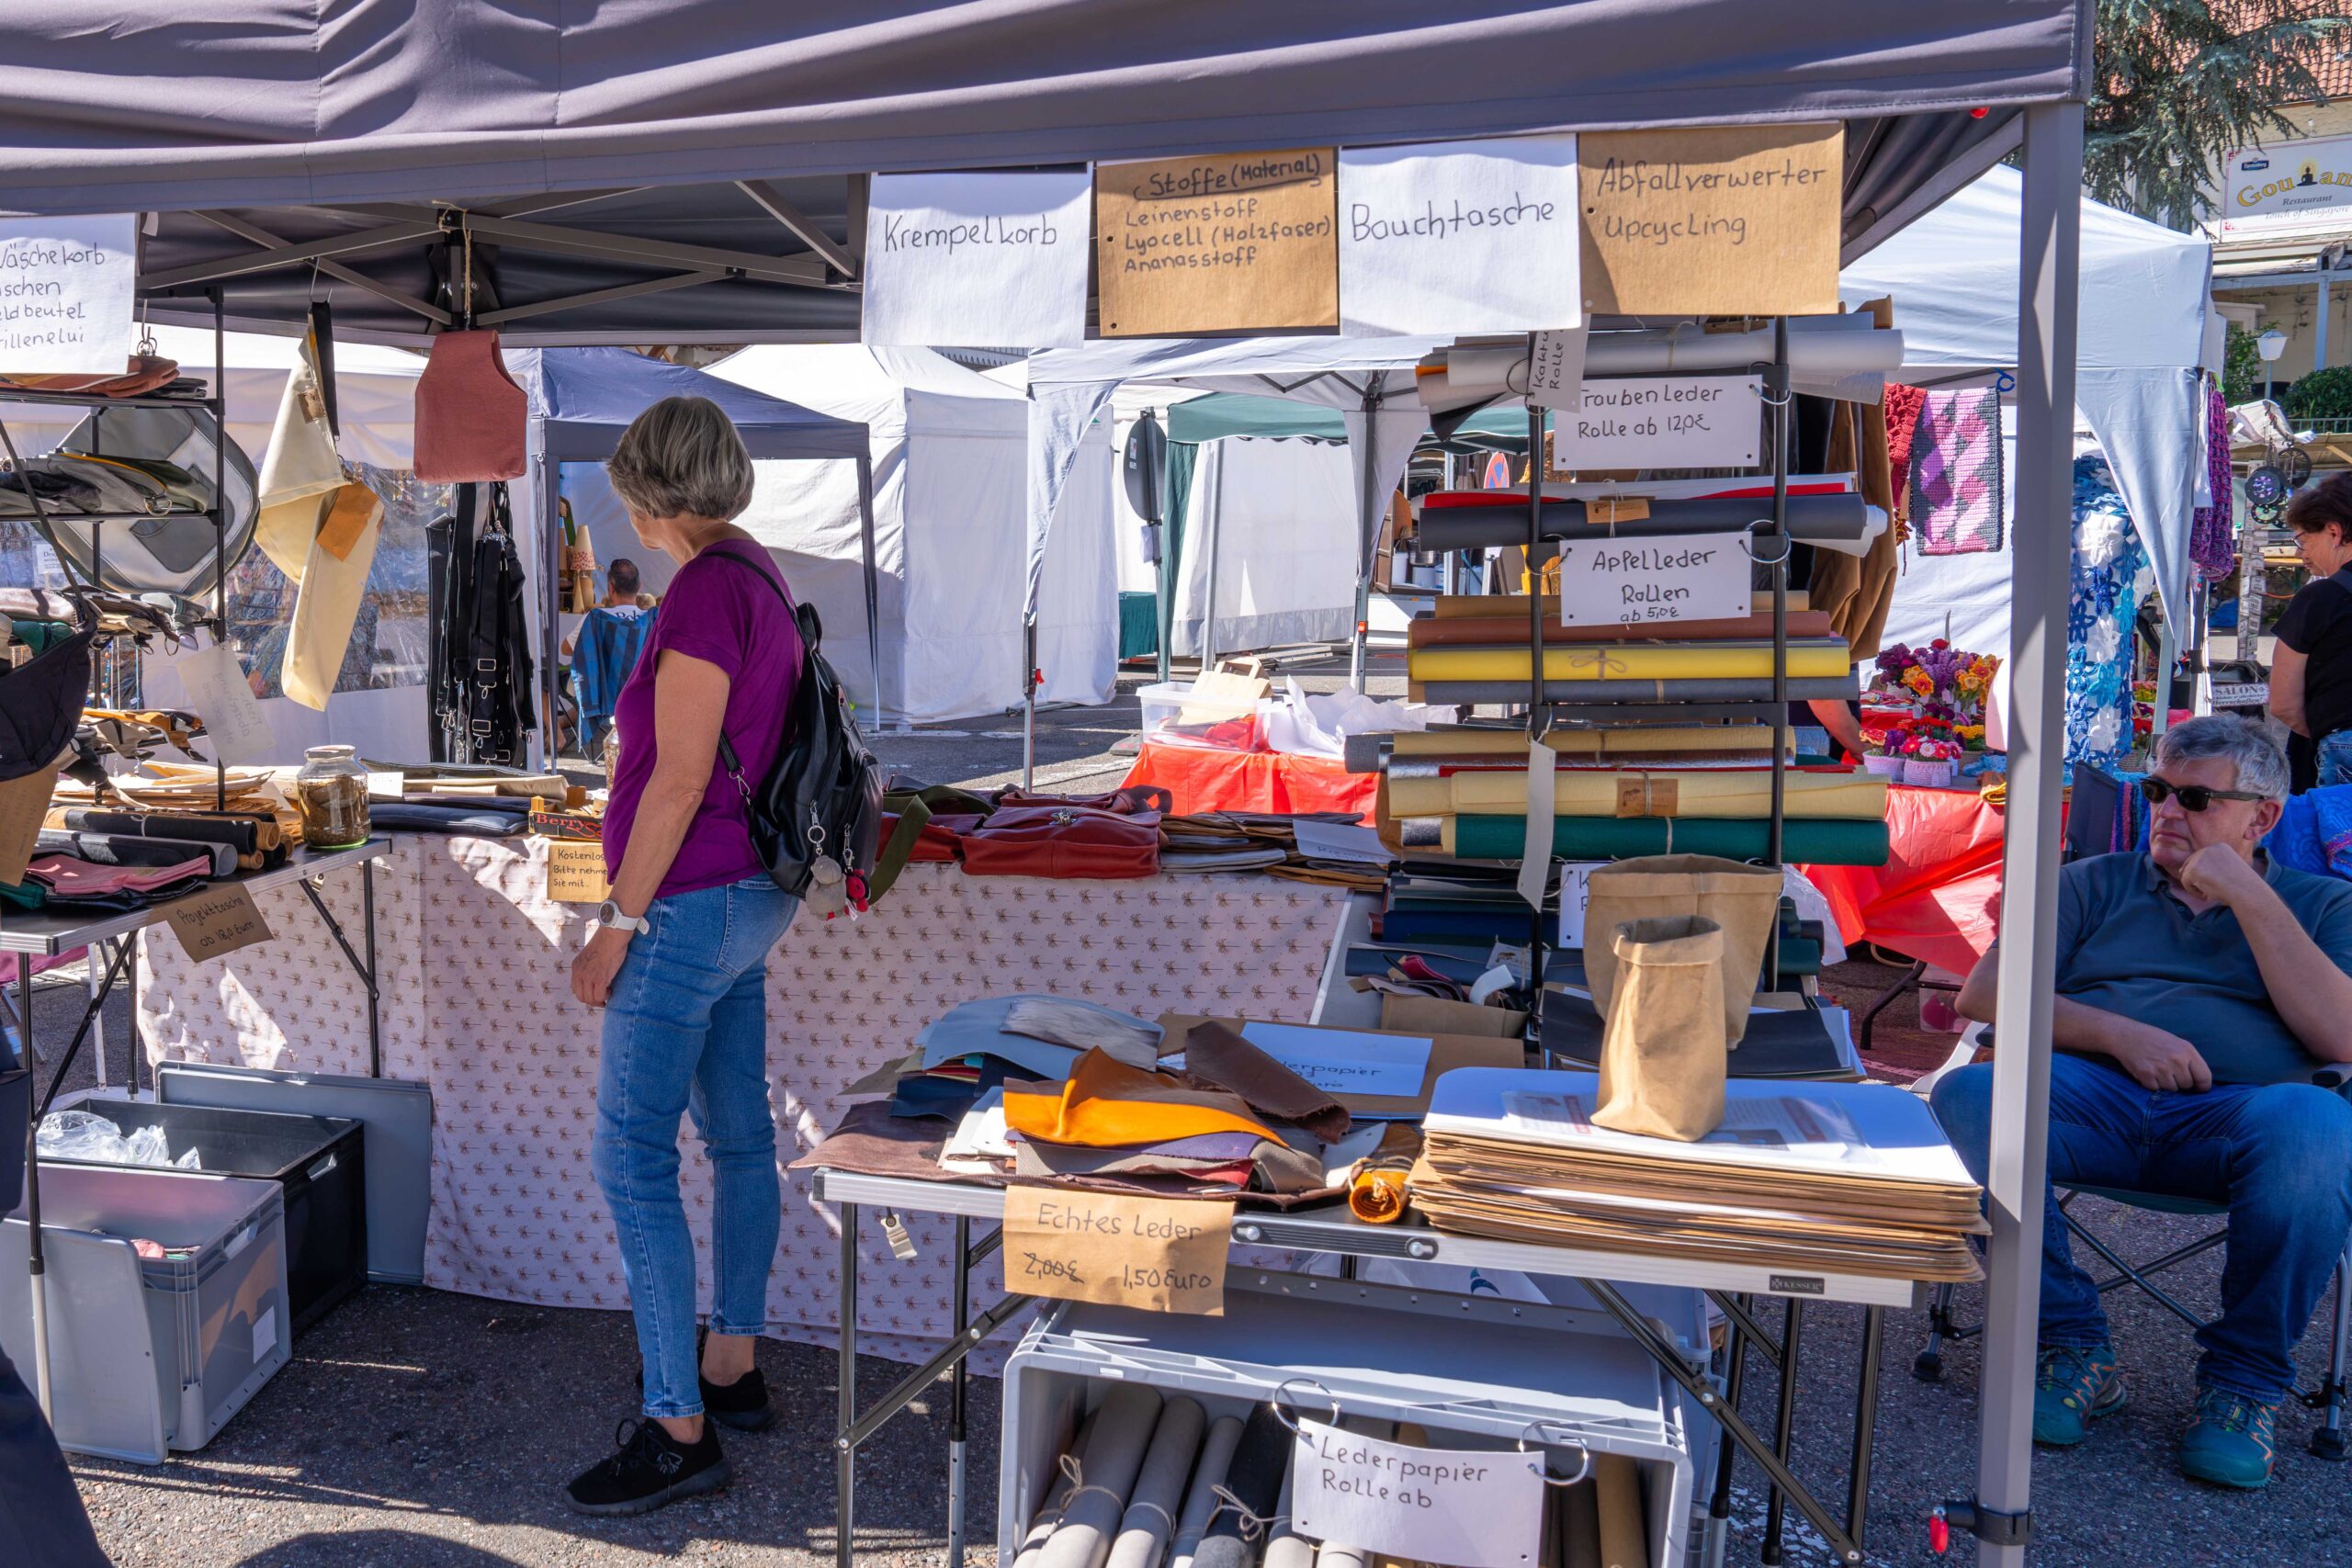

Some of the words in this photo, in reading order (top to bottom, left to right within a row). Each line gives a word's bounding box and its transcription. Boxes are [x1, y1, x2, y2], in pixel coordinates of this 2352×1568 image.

[1149, 167, 1227, 196] Stoffe
[1597, 156, 1828, 198] Abfallverwerter
[1126, 197, 1258, 227] Leinenstoff
[2282, 195, 2333, 206] Restaurant
[1351, 191, 1555, 243] Bauchtasche
[1605, 212, 1747, 245] Upcycling
[885, 213, 1057, 254] Krempelkorb
[1125, 225, 1203, 256] Lyocell
[1124, 246, 1257, 273] Ananasstoff
[0, 275, 62, 297] schen
[1577, 419, 1626, 438] Rolle
[1634, 416, 1657, 435] ab
[1622, 583, 1690, 604] Rollen
[1620, 609, 1641, 622] ab
[553, 864, 576, 874] Bitte
[553, 878, 566, 886] Sie
[199, 935, 215, 947] ab
[233, 921, 254, 934] Euro
[1038, 1203, 1121, 1235] Echtes
[1134, 1214, 1203, 1240] Leder
[1783, 1280, 1820, 1291] KESSER
[1321, 1435, 1488, 1485] Lederpapier
[1323, 1469, 1388, 1500] Rolle
[1398, 1489, 1432, 1508] ab
